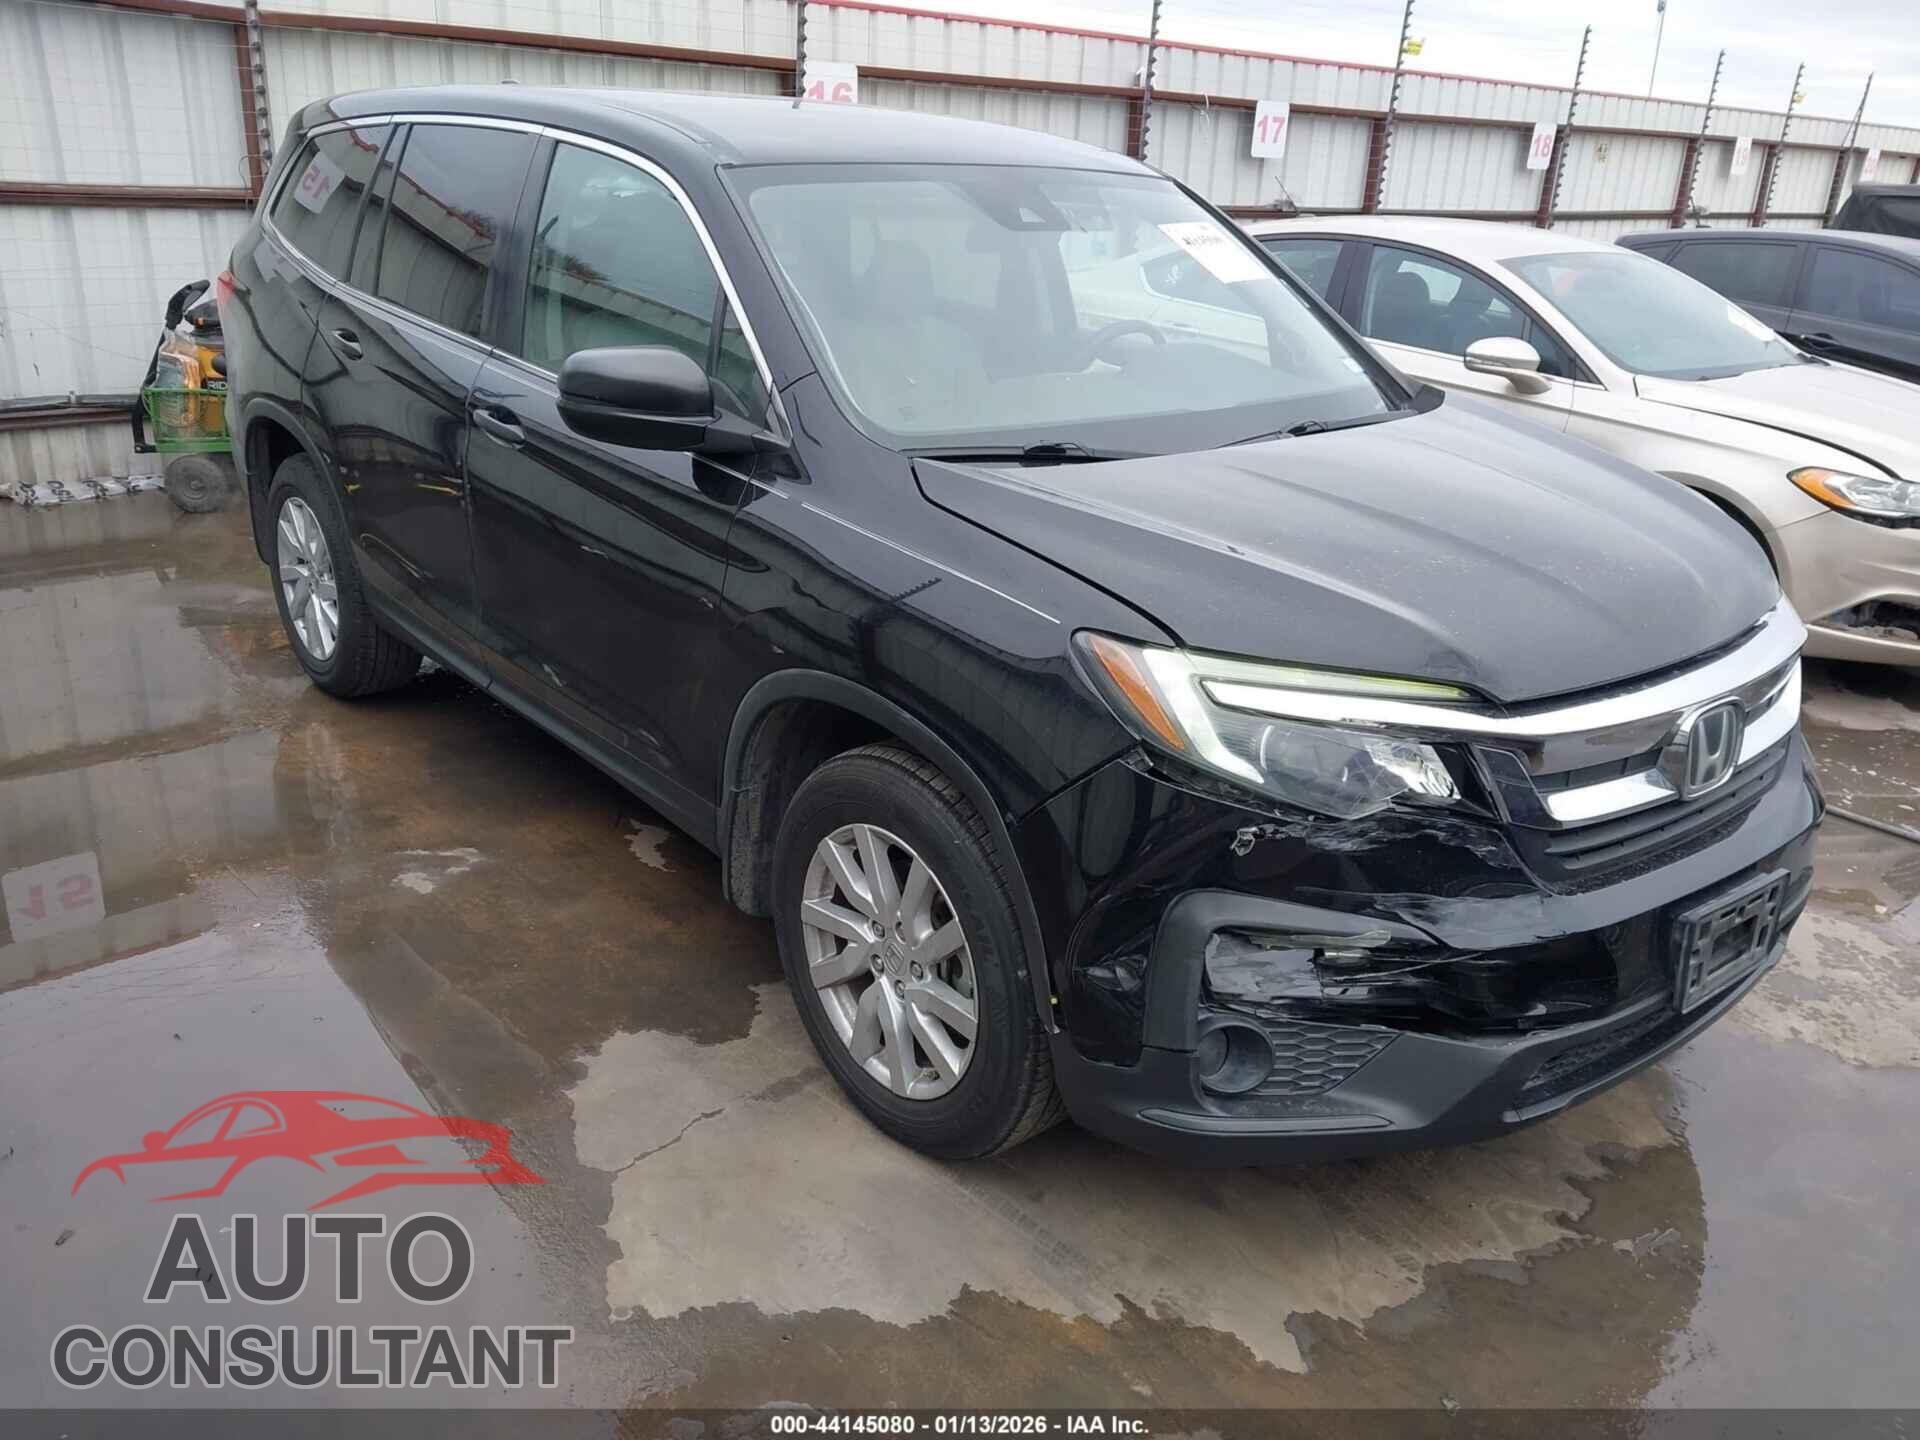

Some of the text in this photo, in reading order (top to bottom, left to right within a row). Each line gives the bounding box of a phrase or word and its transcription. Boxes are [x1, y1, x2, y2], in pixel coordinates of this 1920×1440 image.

[807, 80, 853, 102] 16
[1257, 115, 1286, 144] 17
[1535, 133, 1553, 157] 18
